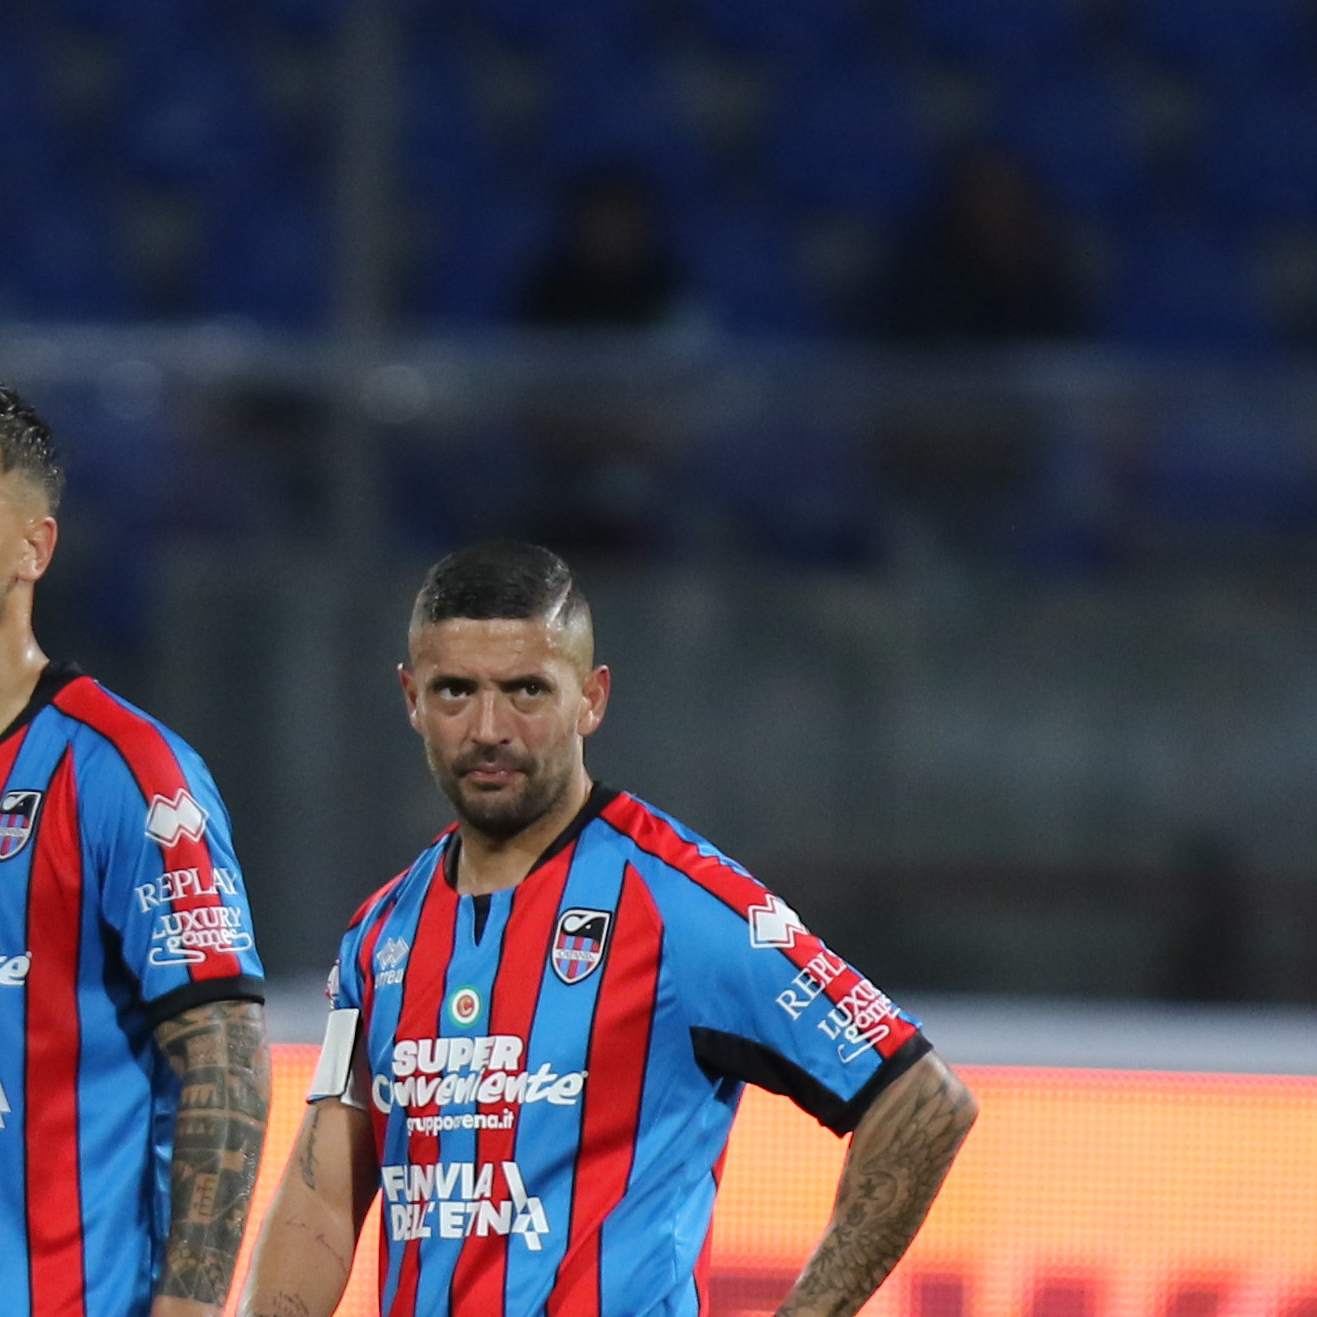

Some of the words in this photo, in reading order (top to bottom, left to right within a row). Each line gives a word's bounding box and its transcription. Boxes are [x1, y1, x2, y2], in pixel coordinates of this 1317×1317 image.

[134, 867, 239, 913] REPLAY
[152, 905, 242, 939] LUXURY
[776, 950, 848, 1021] REPL
[392, 1035, 524, 1077] SUPER
[381, 1161, 494, 1202] FUNVIA
